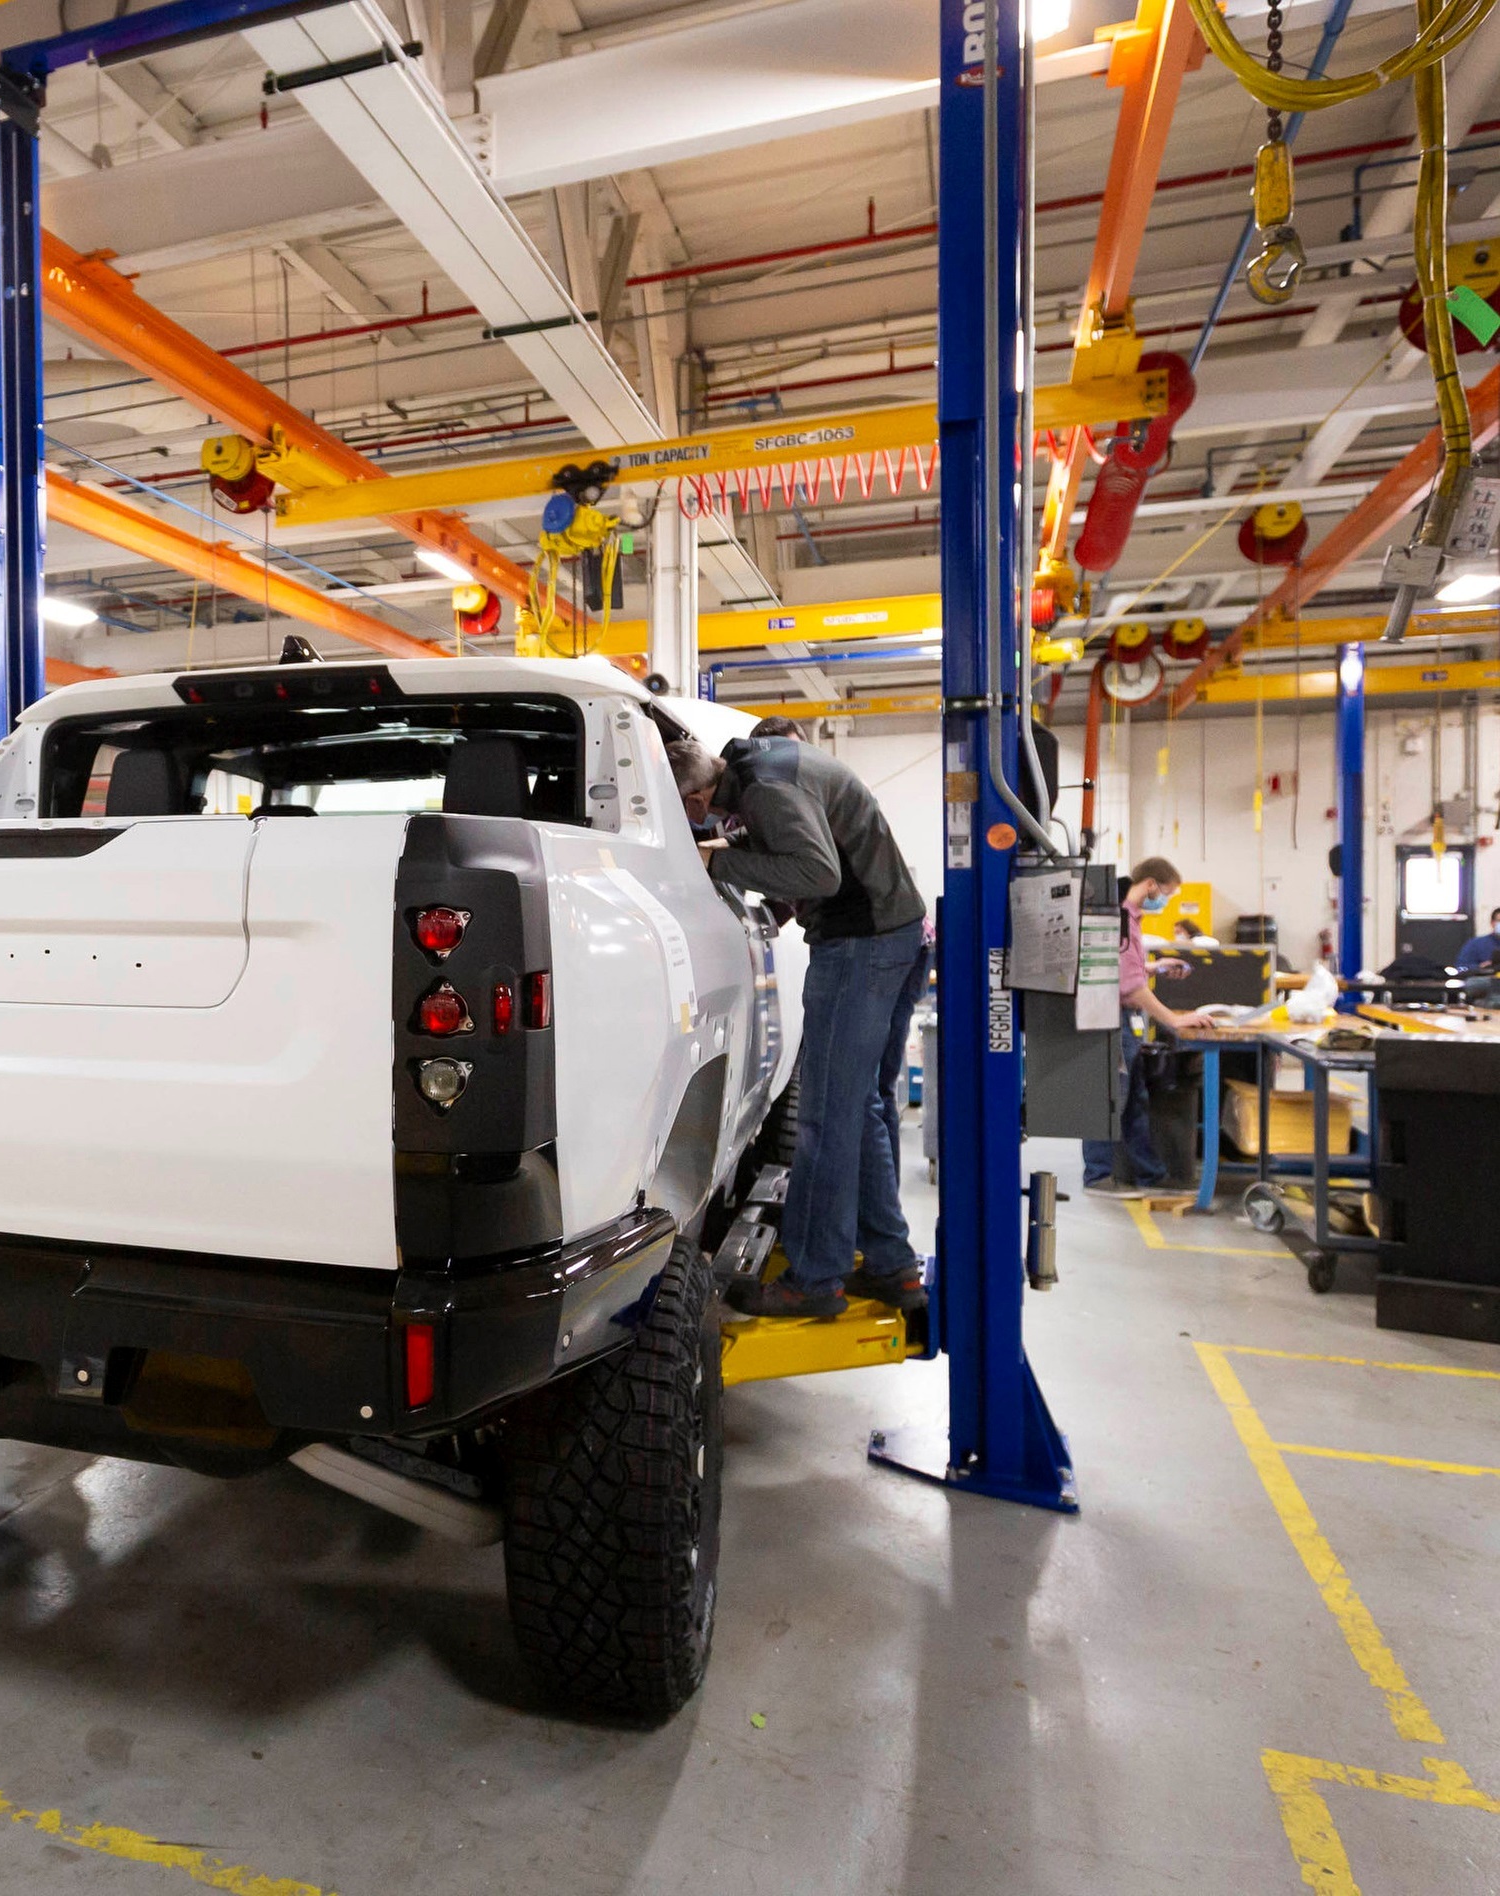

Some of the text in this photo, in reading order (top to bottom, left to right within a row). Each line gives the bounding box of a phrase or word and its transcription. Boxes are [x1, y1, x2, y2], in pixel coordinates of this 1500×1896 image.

[962, 0, 999, 64] RO
[754, 426, 856, 451] SFGBC-1063
[628, 451, 650, 467] TON
[654, 446, 710, 464] CAPACITY
